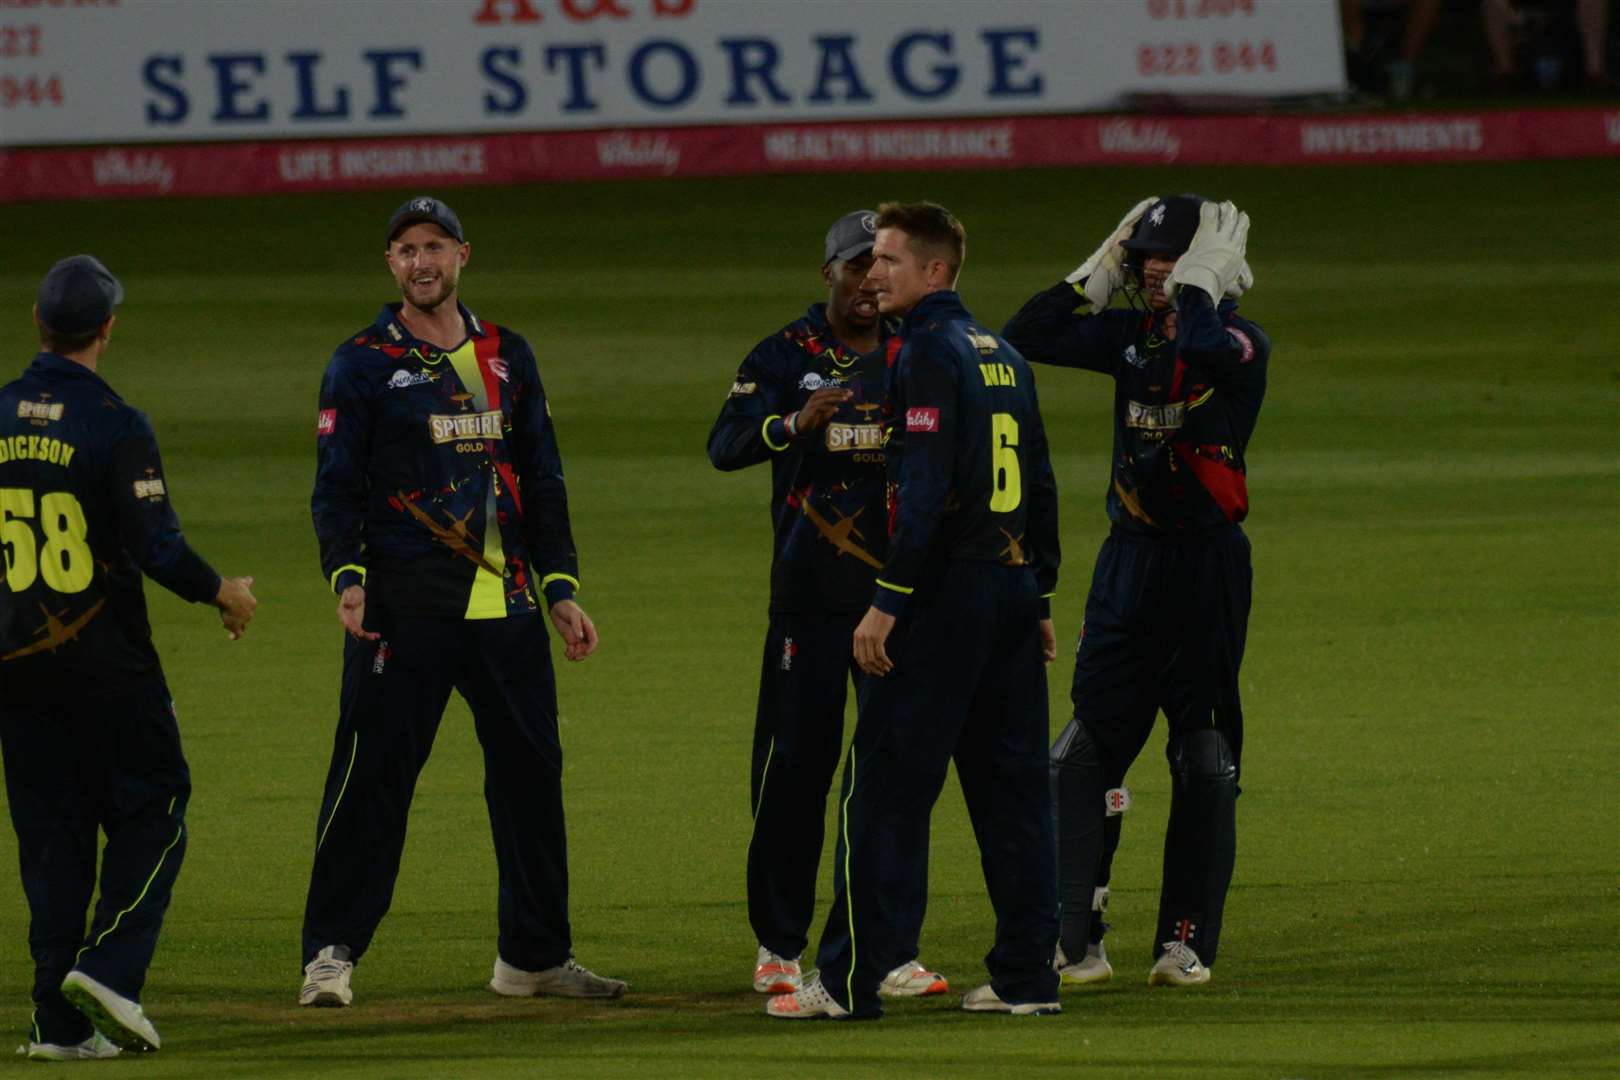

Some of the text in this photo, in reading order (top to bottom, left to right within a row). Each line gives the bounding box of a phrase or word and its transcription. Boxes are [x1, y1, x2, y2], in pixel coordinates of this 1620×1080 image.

[142, 28, 1044, 125] SELF STORAGE
[279, 148, 334, 182] LIFE
[431, 413, 502, 440] SPITFIRE
[0, 434, 75, 468] DICKSON
[456, 442, 485, 454] GOLD
[852, 452, 886, 464] GOLD
[989, 412, 1022, 513] 6
[0, 487, 95, 594] 58
